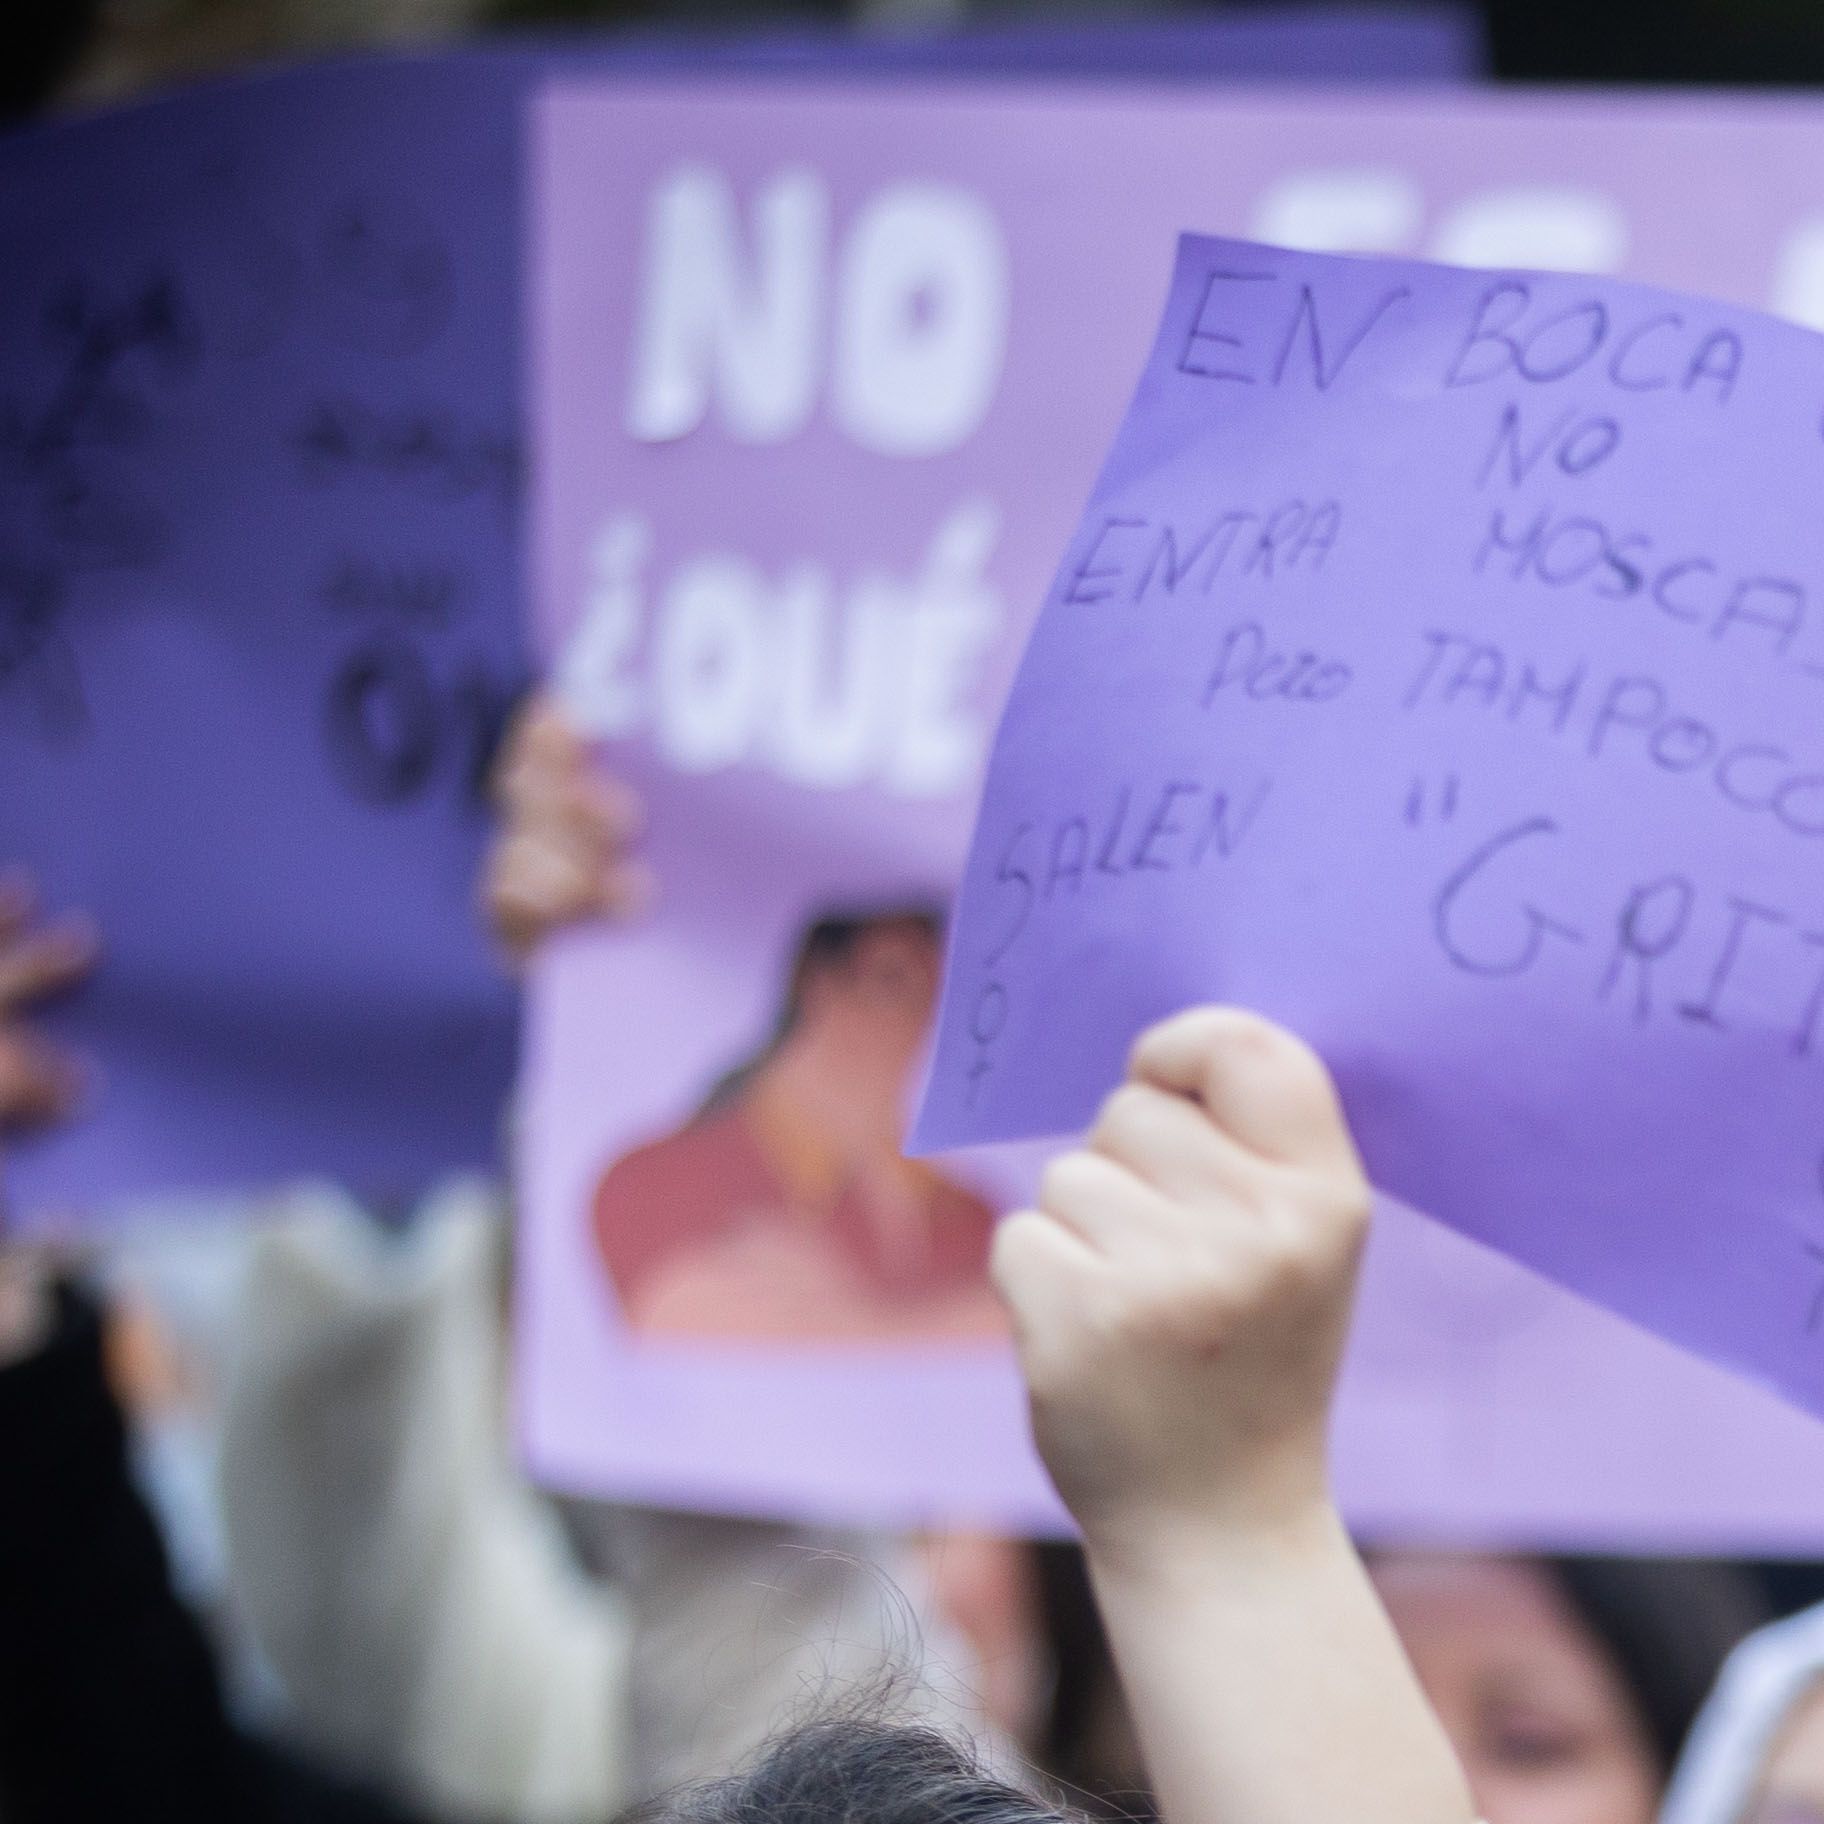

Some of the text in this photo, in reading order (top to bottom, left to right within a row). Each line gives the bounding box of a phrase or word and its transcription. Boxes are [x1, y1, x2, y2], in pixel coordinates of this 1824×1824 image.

[638, 168, 1000, 455] NO
[1175, 267, 1412, 392] EN
[1443, 278, 1745, 405] BOCA
[1474, 402, 1621, 492] NO
[1060, 498, 1343, 606] ENTRA
[982, 775, 1275, 968] SALEN
